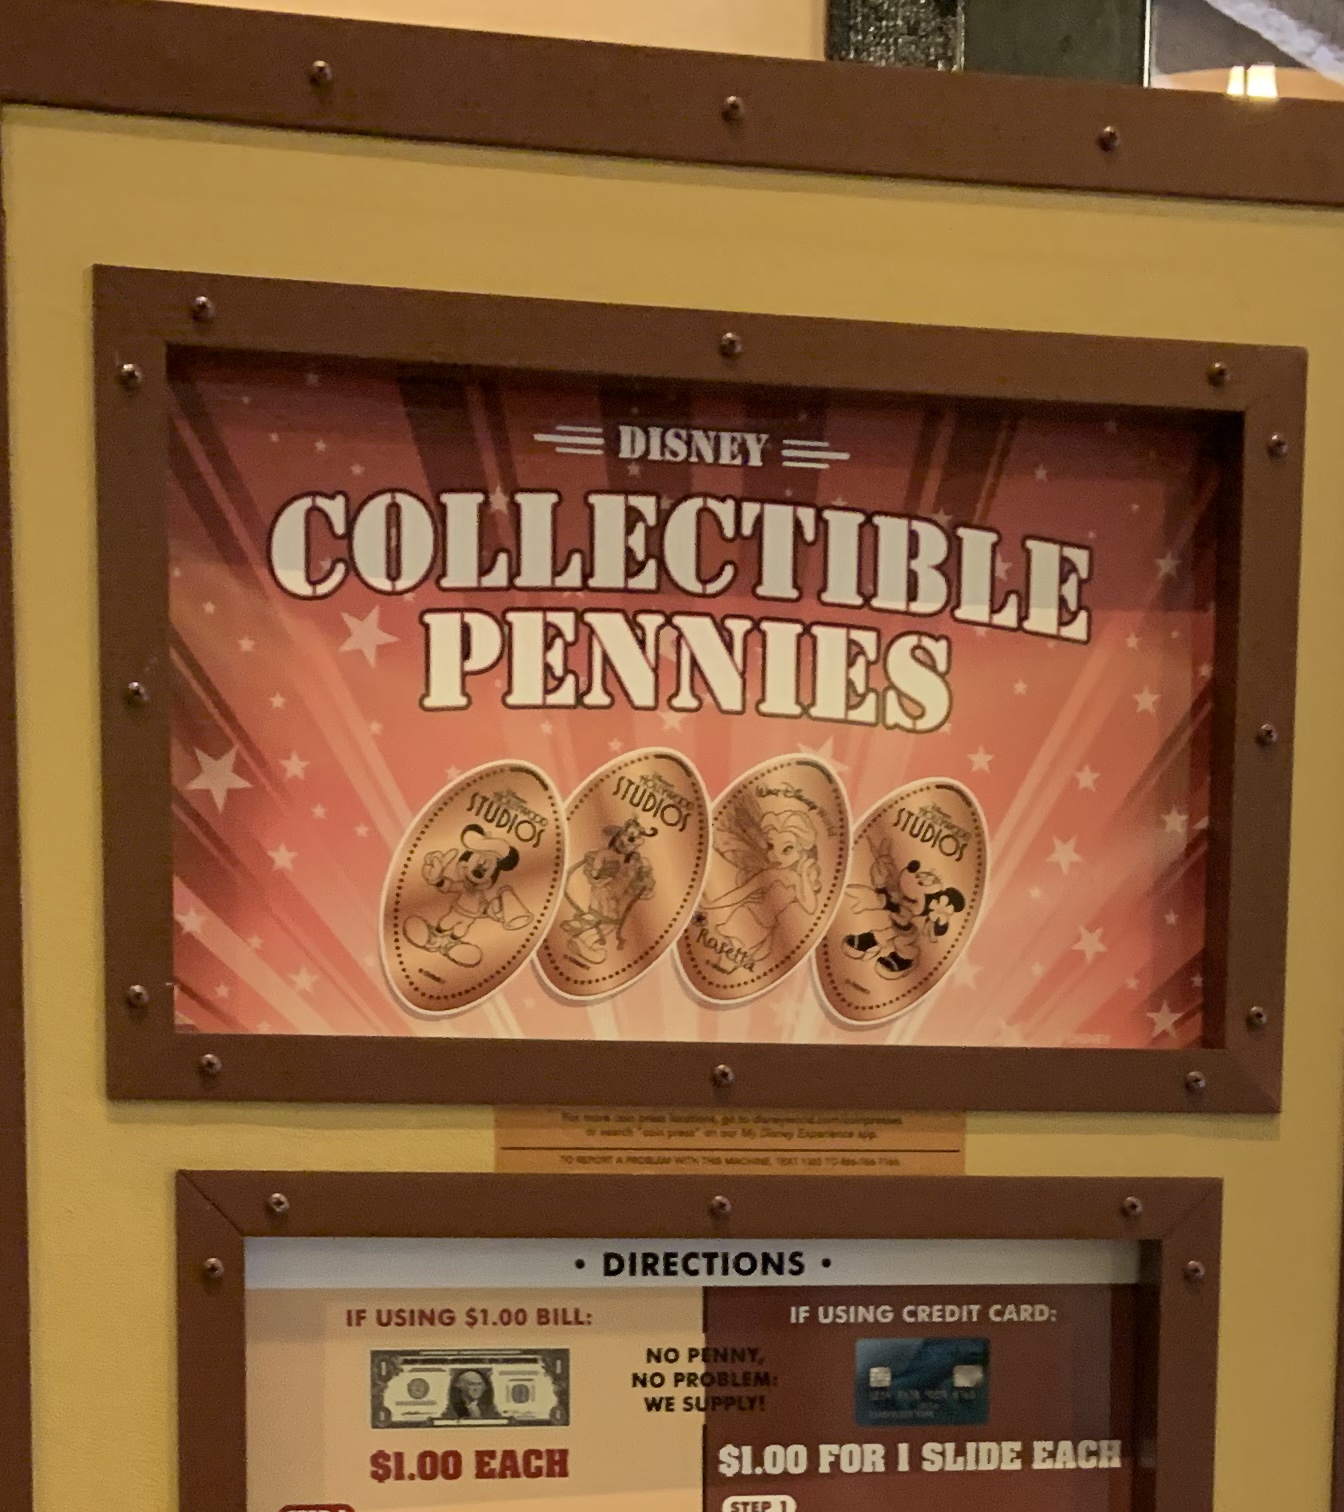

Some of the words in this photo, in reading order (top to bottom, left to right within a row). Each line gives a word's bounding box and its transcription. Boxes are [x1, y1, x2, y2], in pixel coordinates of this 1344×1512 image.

[618, 425, 770, 469] DISNEY
[267, 488, 1094, 644] COLLECTIBLE
[420, 608, 954, 735] PENNIES
[466, 792, 545, 848] STUDIOS
[612, 776, 691, 832] STUDIOS
[893, 808, 968, 862] STUDIOS
[603, 1251, 805, 1277] DIRECTIONS
[346, 1308, 367, 1327] IF
[376, 1307, 456, 1327] USING
[465, 1305, 527, 1327] $1.00
[537, 1307, 592, 1326] BILL:
[790, 1306, 809, 1324] IF
[819, 1305, 893, 1324] USING
[902, 1304, 980, 1323] CREDIT
[989, 1304, 1057, 1322] CARD:
[646, 1347, 680, 1364] NO
[688, 1347, 765, 1366] PENNY,
[631, 1371, 665, 1389] NO
[644, 1396, 677, 1413] WE
[683, 1395, 766, 1413] SUPPLY!
[370, 1450, 463, 1484] $1.00
[474, 1448, 570, 1480] EACH
[718, 1444, 807, 1477] $1.00
[818, 1443, 885, 1473] FOR
[896, 1443, 910, 1472] 1
[922, 1441, 1023, 1472] SLIDE
[1031, 1440, 1123, 1470] EACH
